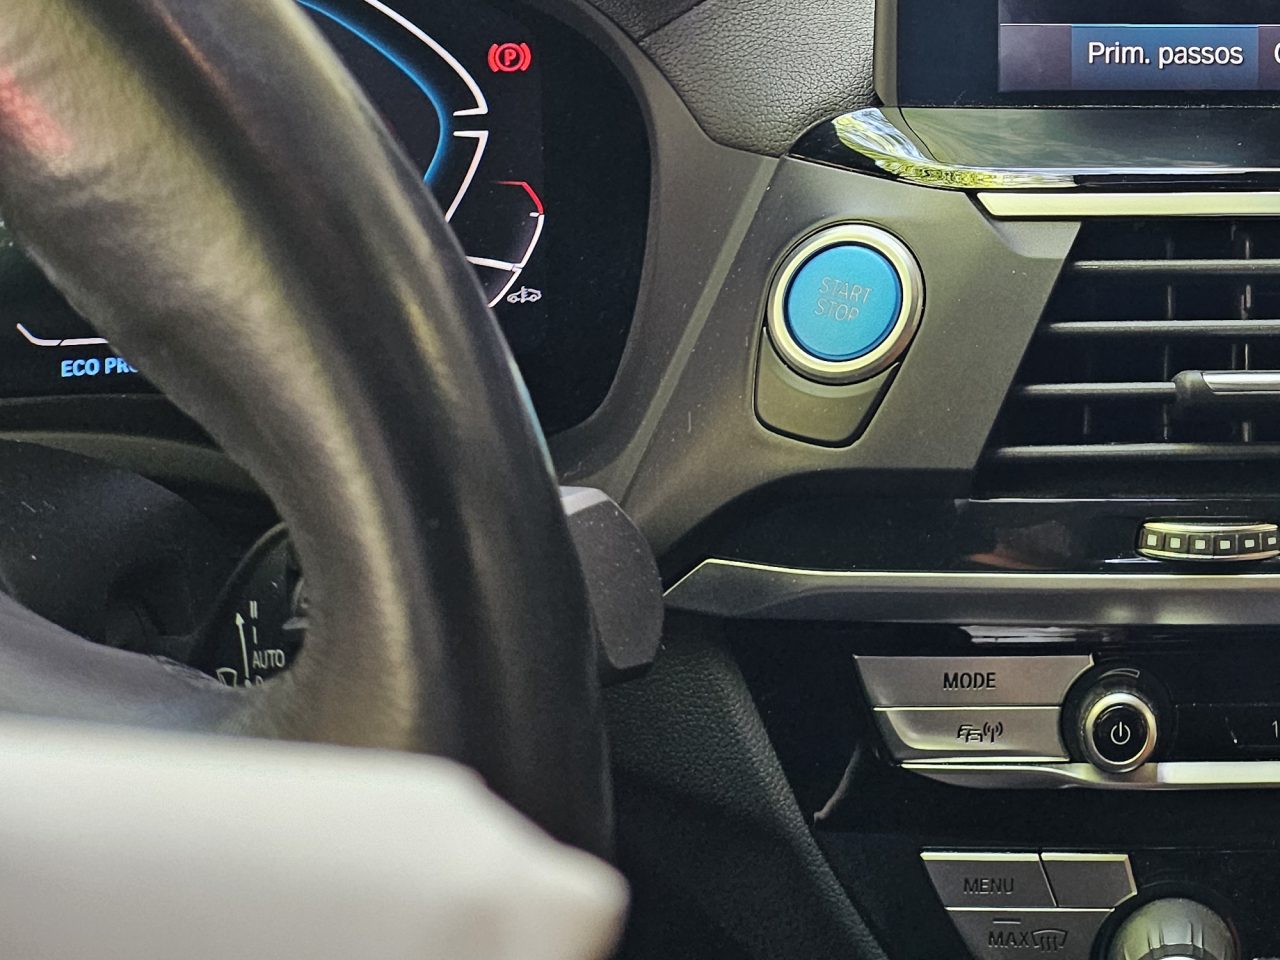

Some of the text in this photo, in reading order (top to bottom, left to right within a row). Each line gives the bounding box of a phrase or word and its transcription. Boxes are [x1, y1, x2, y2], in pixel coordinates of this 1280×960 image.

[1088, 42, 1244, 69] Prim. passos
[819, 276, 873, 304] START
[815, 299, 859, 321] STOP
[61, 358, 100, 378] ECO
[252, 648, 285, 669] AUTO
[943, 672, 997, 689] MODE
[1271, 720, 1279, 738] 1
[963, 877, 1015, 894] MENU
[988, 930, 1030, 948] MAX
